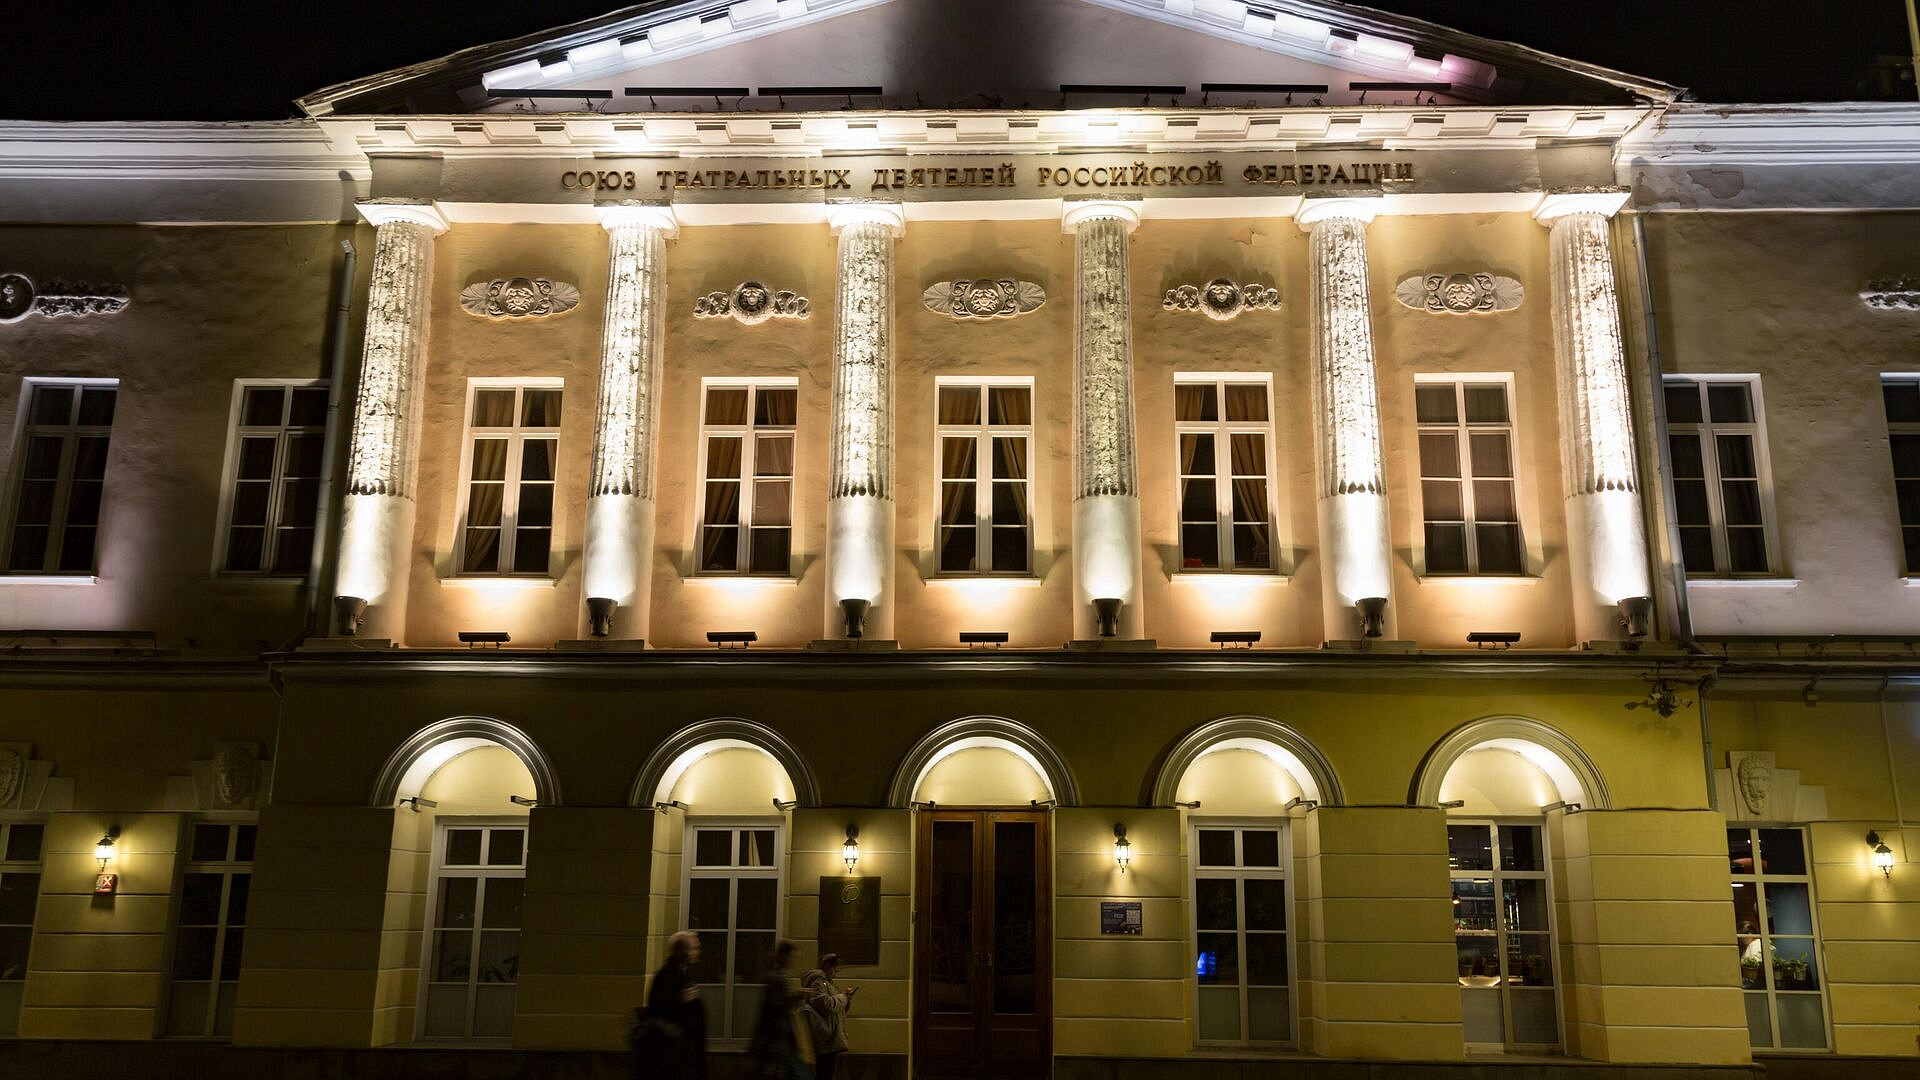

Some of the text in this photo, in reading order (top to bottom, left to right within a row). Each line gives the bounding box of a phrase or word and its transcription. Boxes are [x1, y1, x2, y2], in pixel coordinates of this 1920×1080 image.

[561, 160, 1415, 192] СОЮЗ ТЕАТРАЛЬНЫХ ДЕЯТЕЛЕЙ РОССИЙСКОЙ ФЕДЕРАЦИИ
